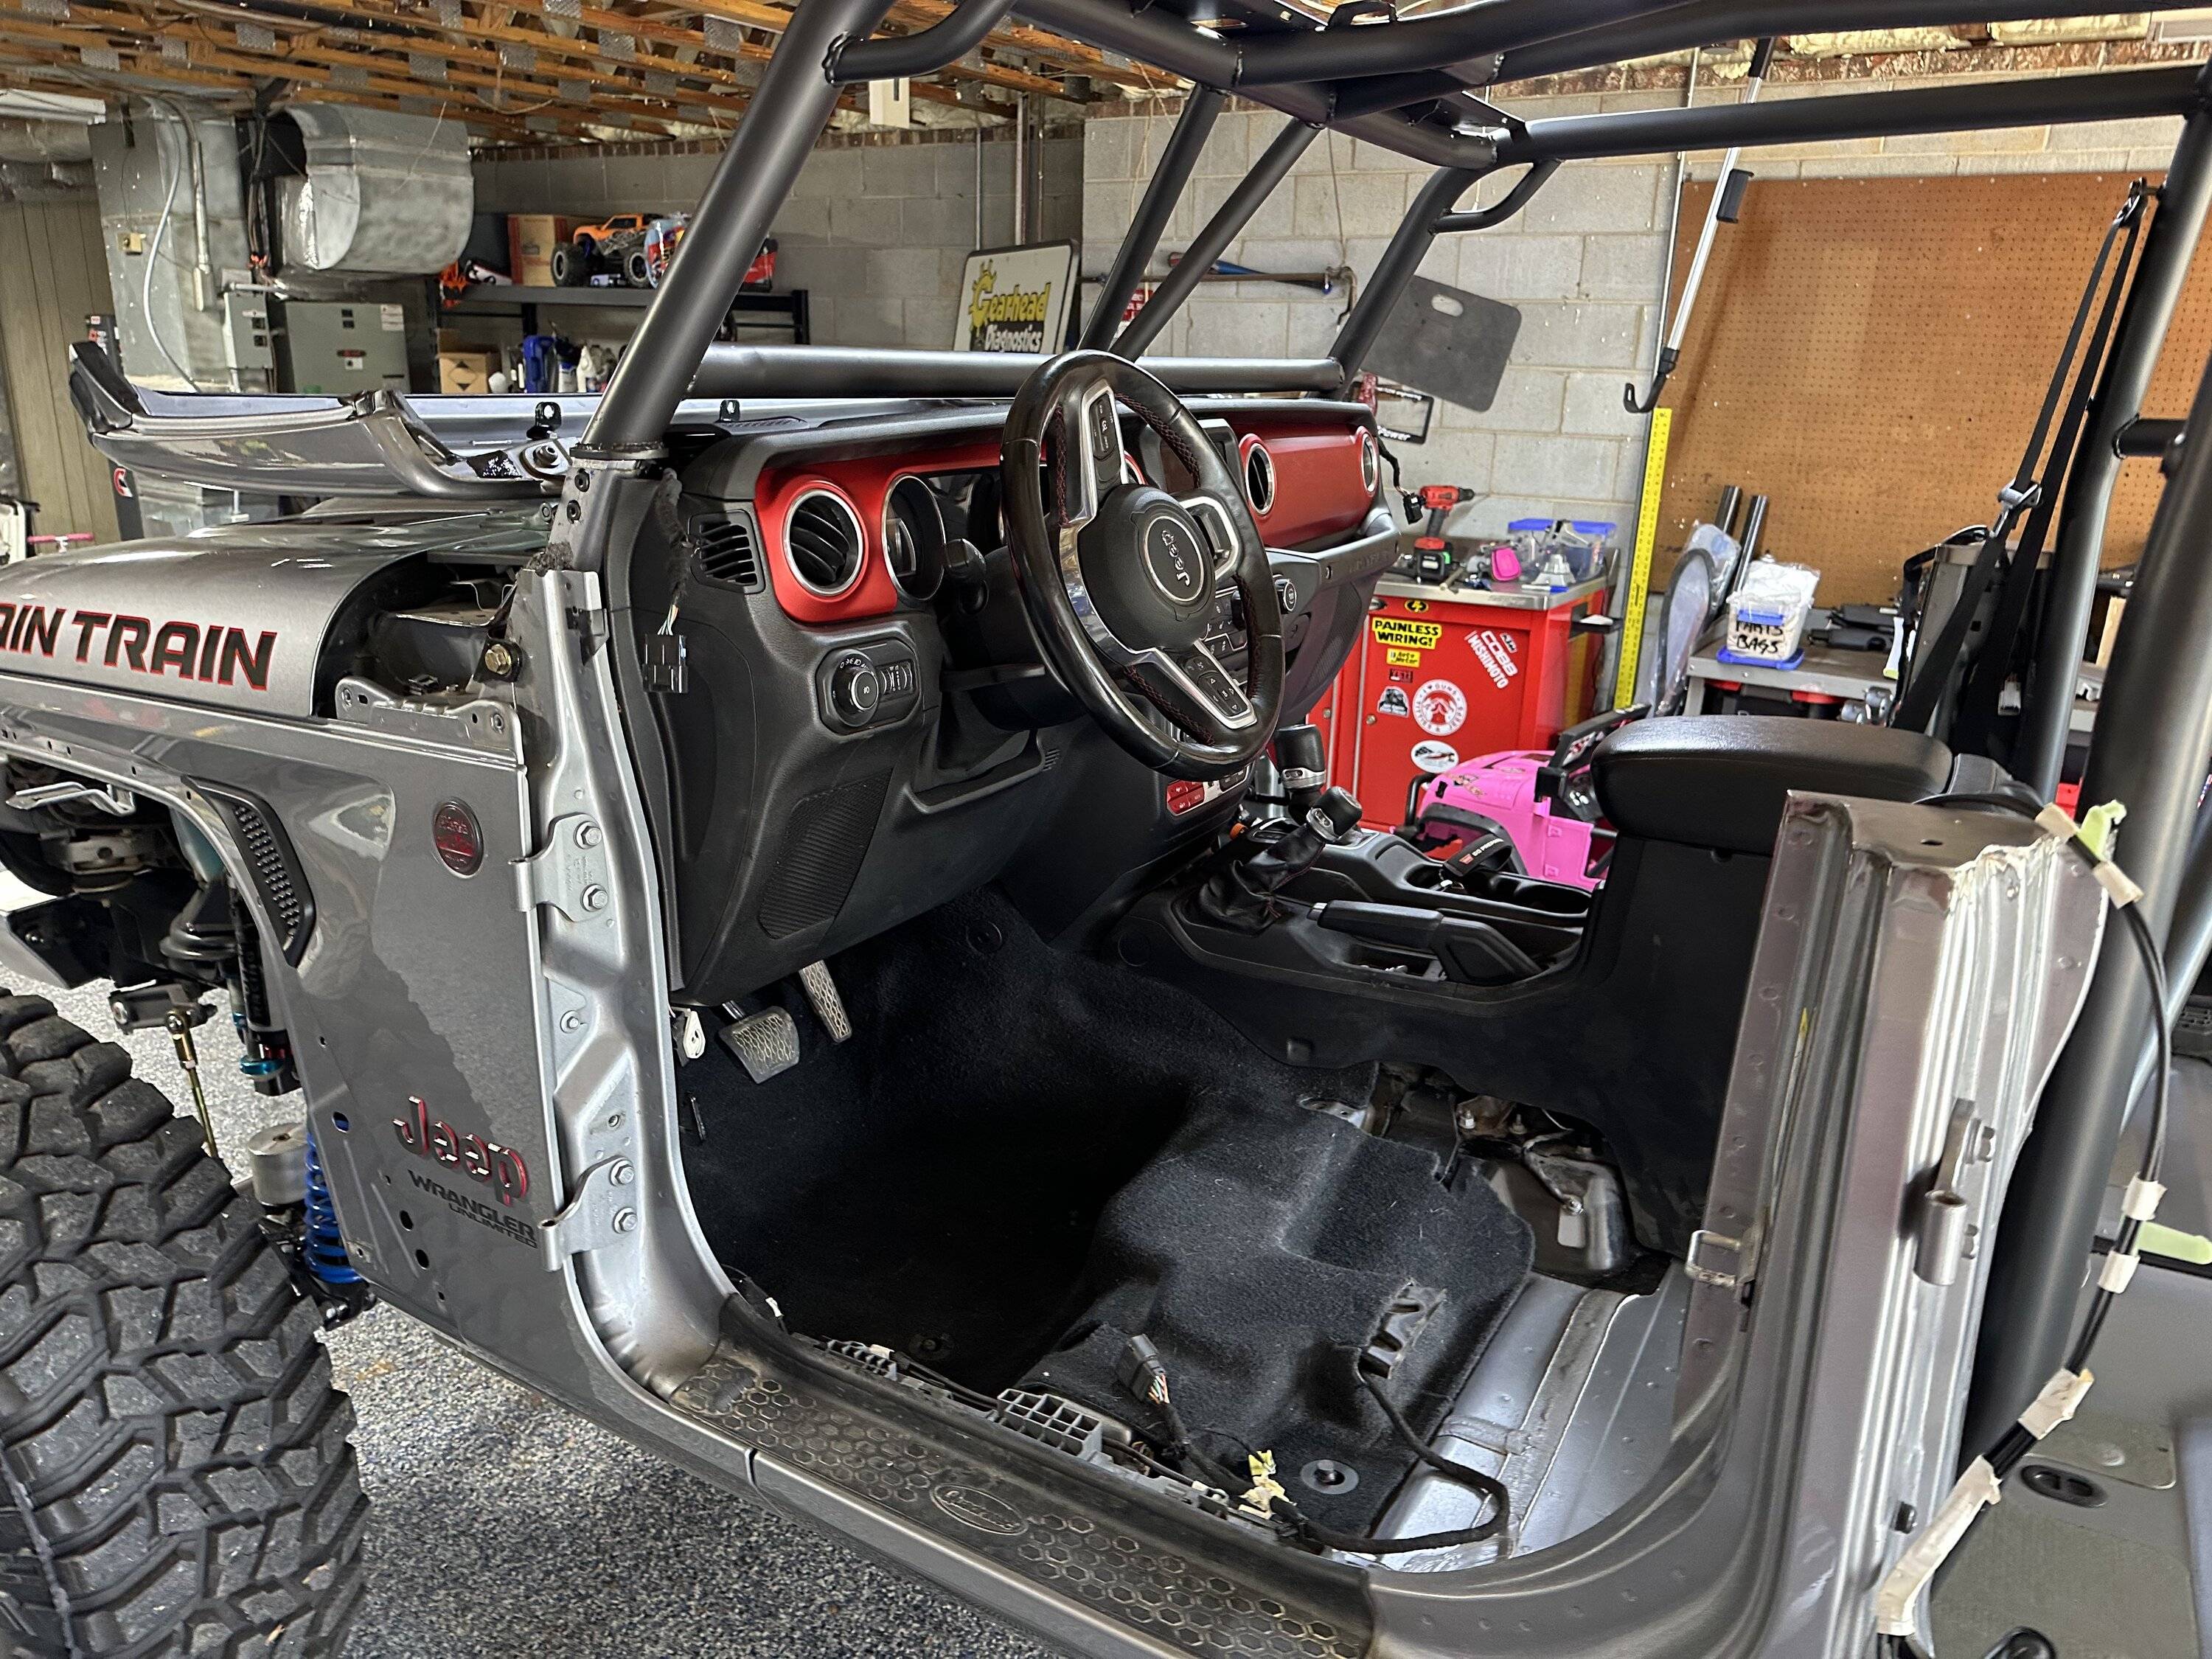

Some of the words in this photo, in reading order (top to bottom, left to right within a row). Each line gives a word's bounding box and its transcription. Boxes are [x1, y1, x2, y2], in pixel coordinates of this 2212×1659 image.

[968, 267, 1051, 328] Gearhead
[985, 324, 1042, 352] Diagnostics
[1161, 529, 1190, 586] Jeep
[72, 610, 278, 691] TRAIN
[1374, 620, 1439, 636] PAINLESS
[1377, 631, 1433, 647] WIRING!
[1481, 630, 1518, 677] COBB
[1736, 634, 1783, 655] BAGS
[1467, 634, 1509, 689] MISHIMOTO
[392, 1096, 529, 1208] Jeep
[407, 1169, 537, 1242] WRANGLER
[448, 1202, 538, 1250] UNLIMITED
